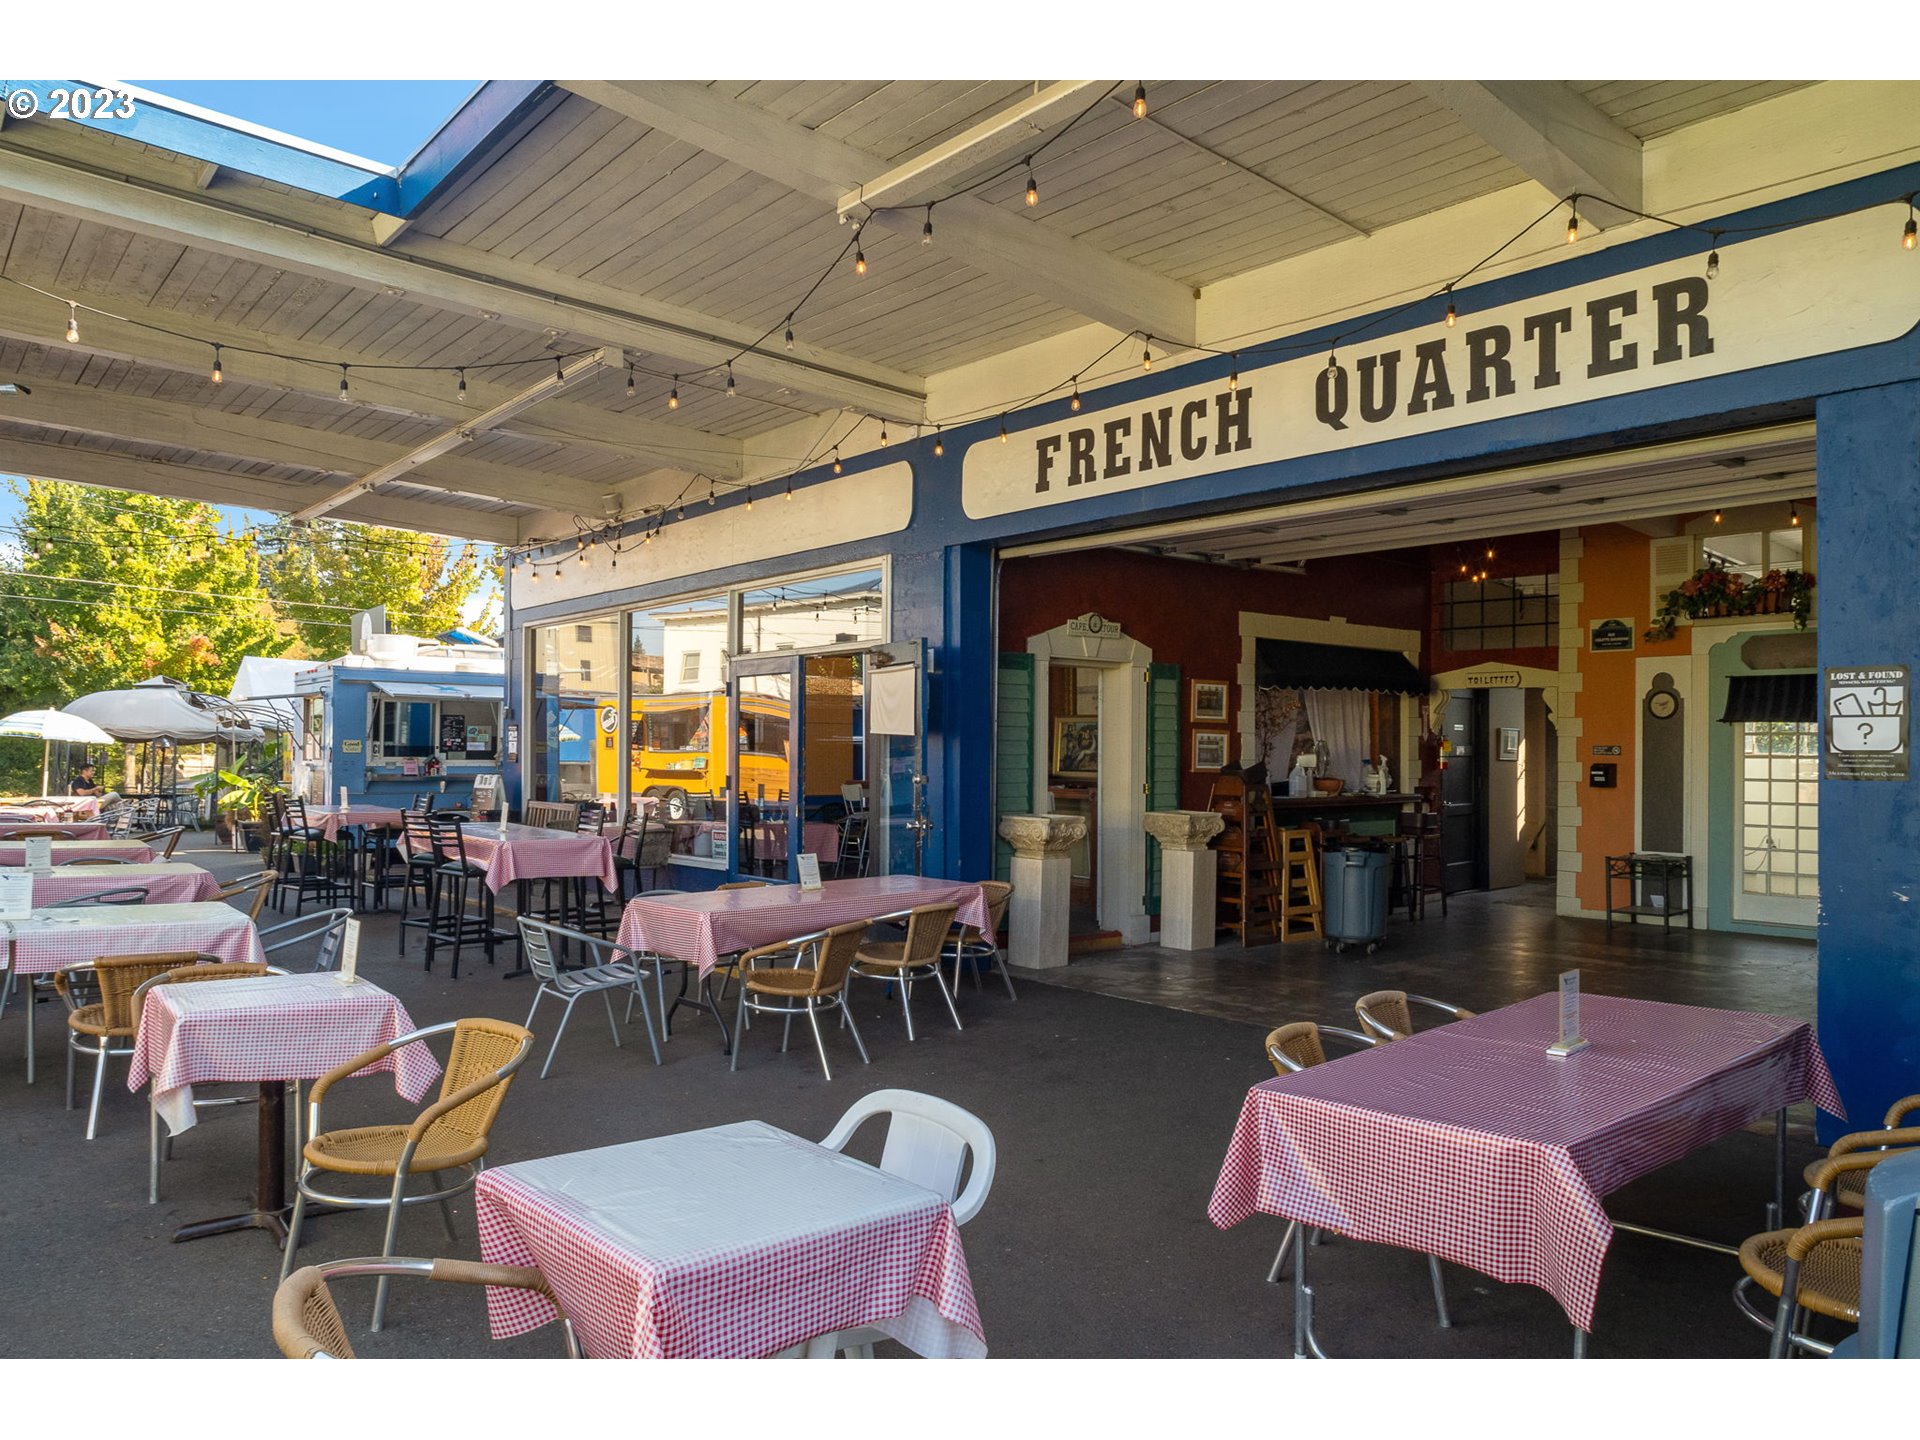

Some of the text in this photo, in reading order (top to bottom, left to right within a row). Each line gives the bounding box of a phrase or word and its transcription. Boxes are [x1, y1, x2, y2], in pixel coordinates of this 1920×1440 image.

[1035, 276, 1715, 493] FRENCH QUARTER
[1467, 675, 1515, 685] TOILETTES
[1830, 670, 1904, 680] LOST & FOUND
